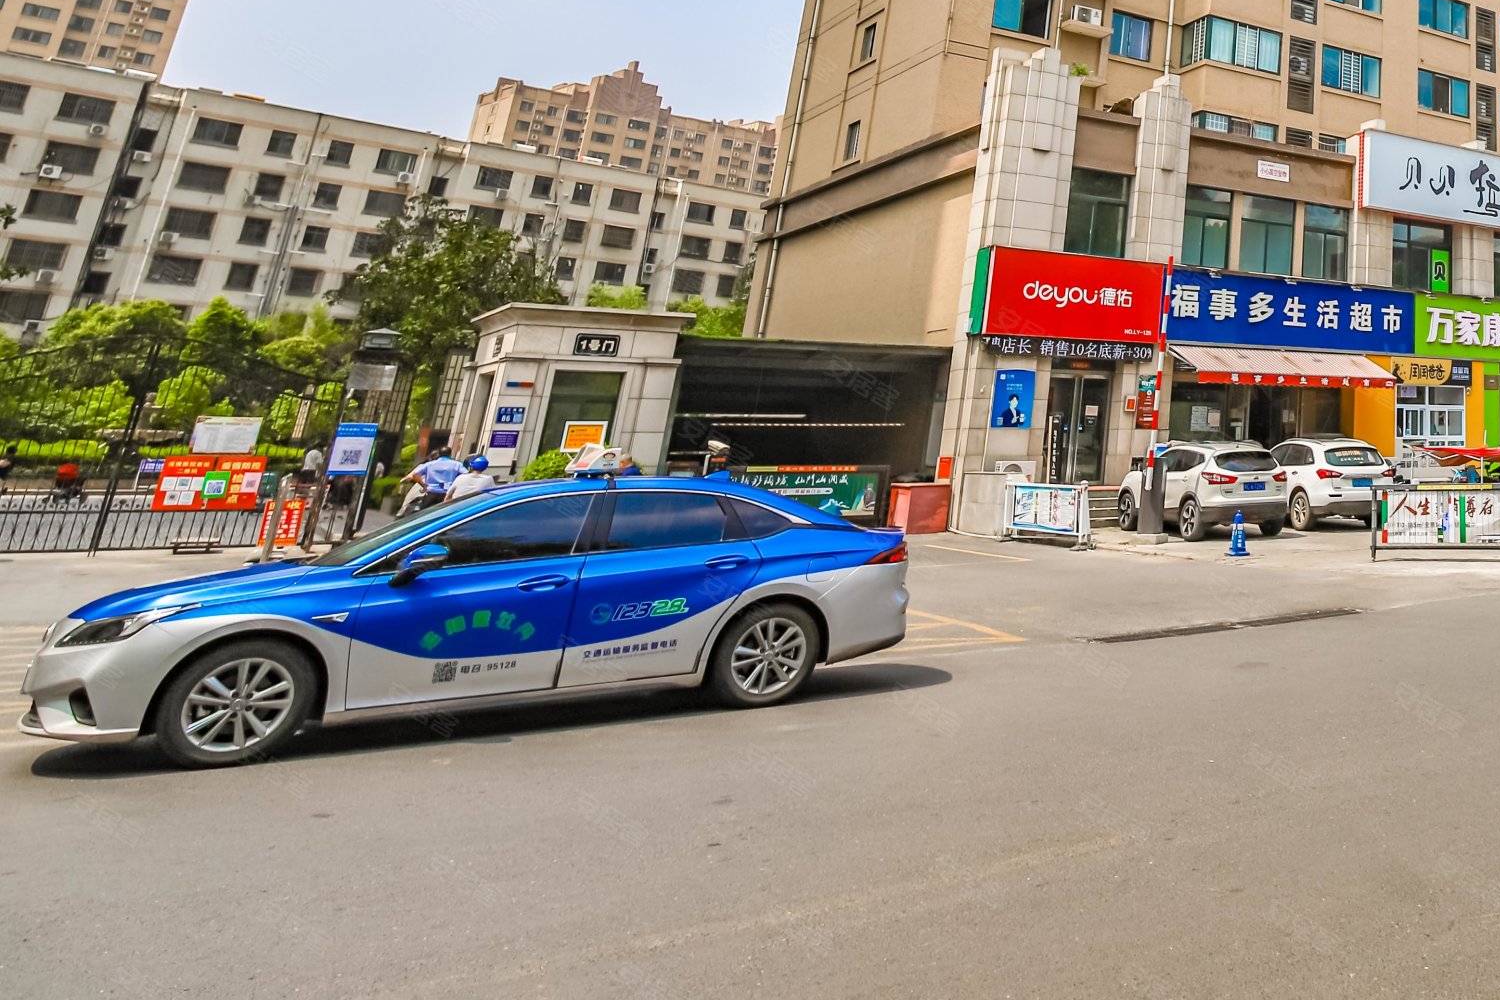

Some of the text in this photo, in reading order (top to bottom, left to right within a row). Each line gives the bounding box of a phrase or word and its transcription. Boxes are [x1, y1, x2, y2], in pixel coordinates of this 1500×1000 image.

[1022, 280, 1133, 308] deyou 德佑
[1171, 284, 1403, 334] 福事多生活超市
[580, 339, 615, 351] 1号门
[583, 639, 678, 659] 交通运输服务监督电话
